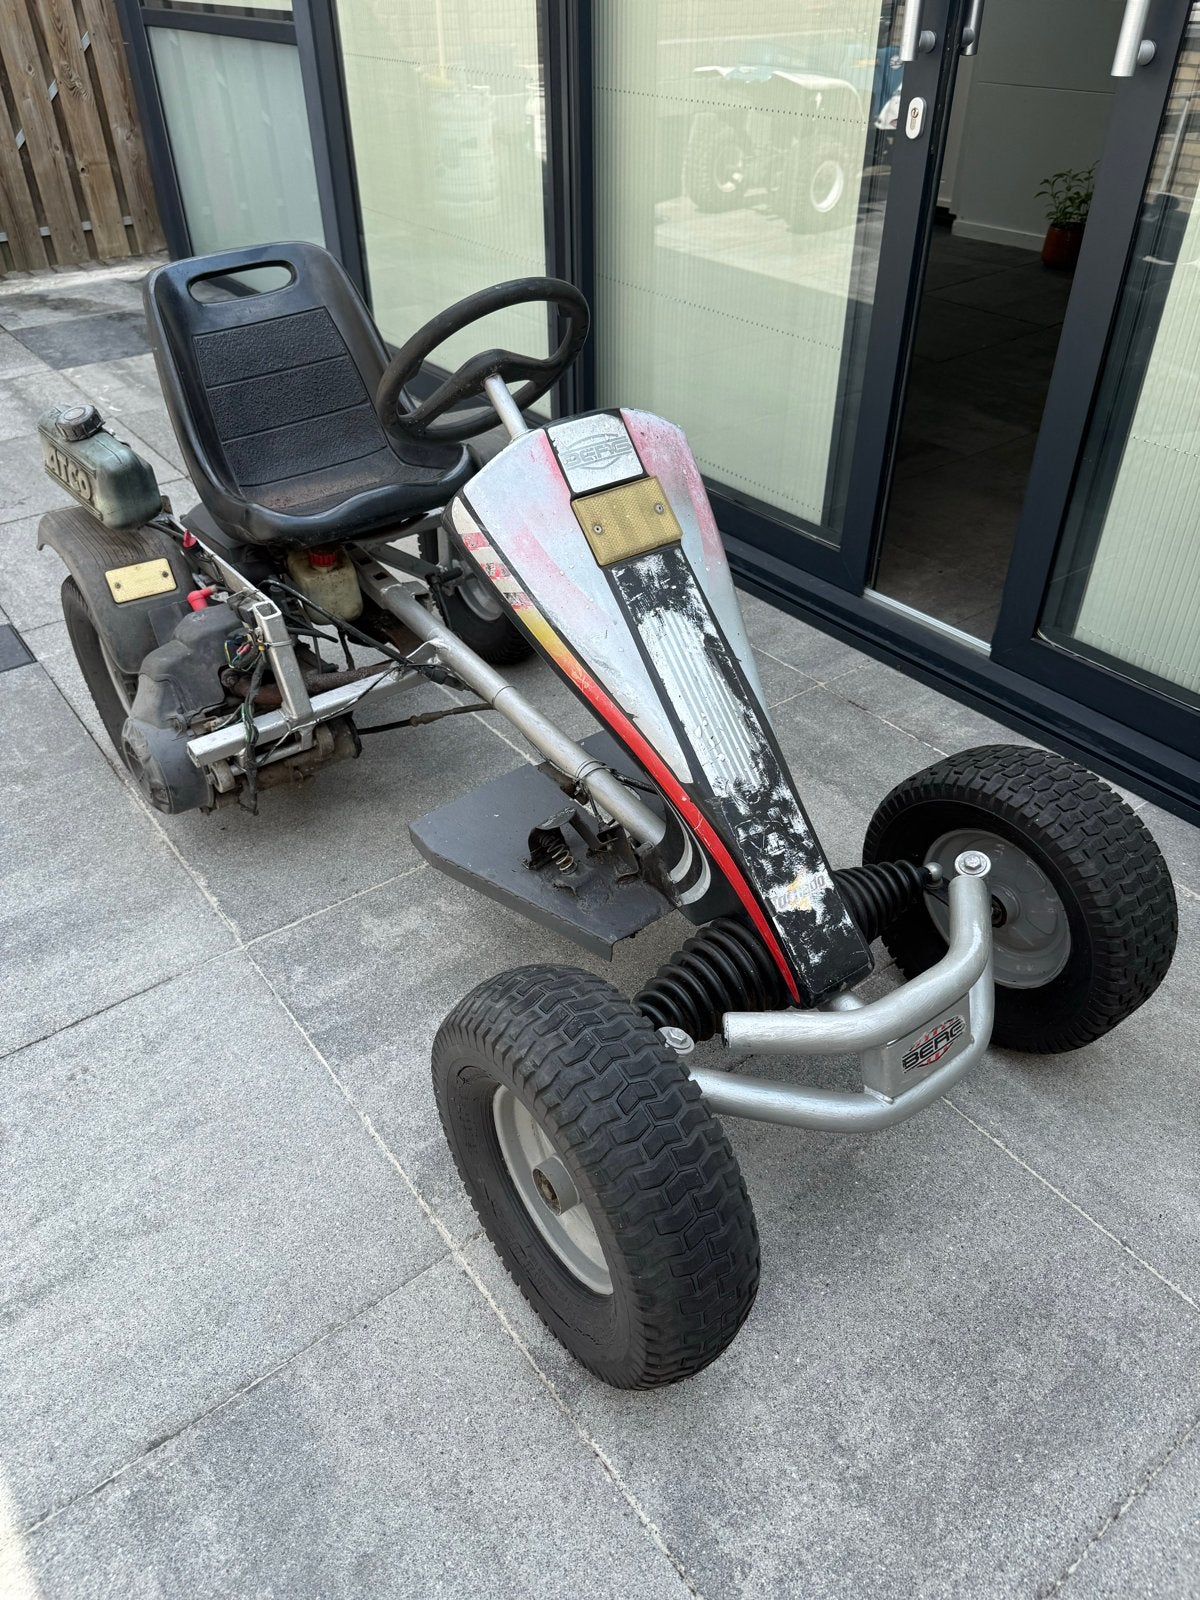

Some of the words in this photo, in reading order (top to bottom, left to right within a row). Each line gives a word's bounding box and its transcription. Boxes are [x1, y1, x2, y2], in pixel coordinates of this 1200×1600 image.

[49, 448, 96, 502] ATCO
[564, 440, 633, 465] BERG
[901, 1018, 966, 1071] BERG
